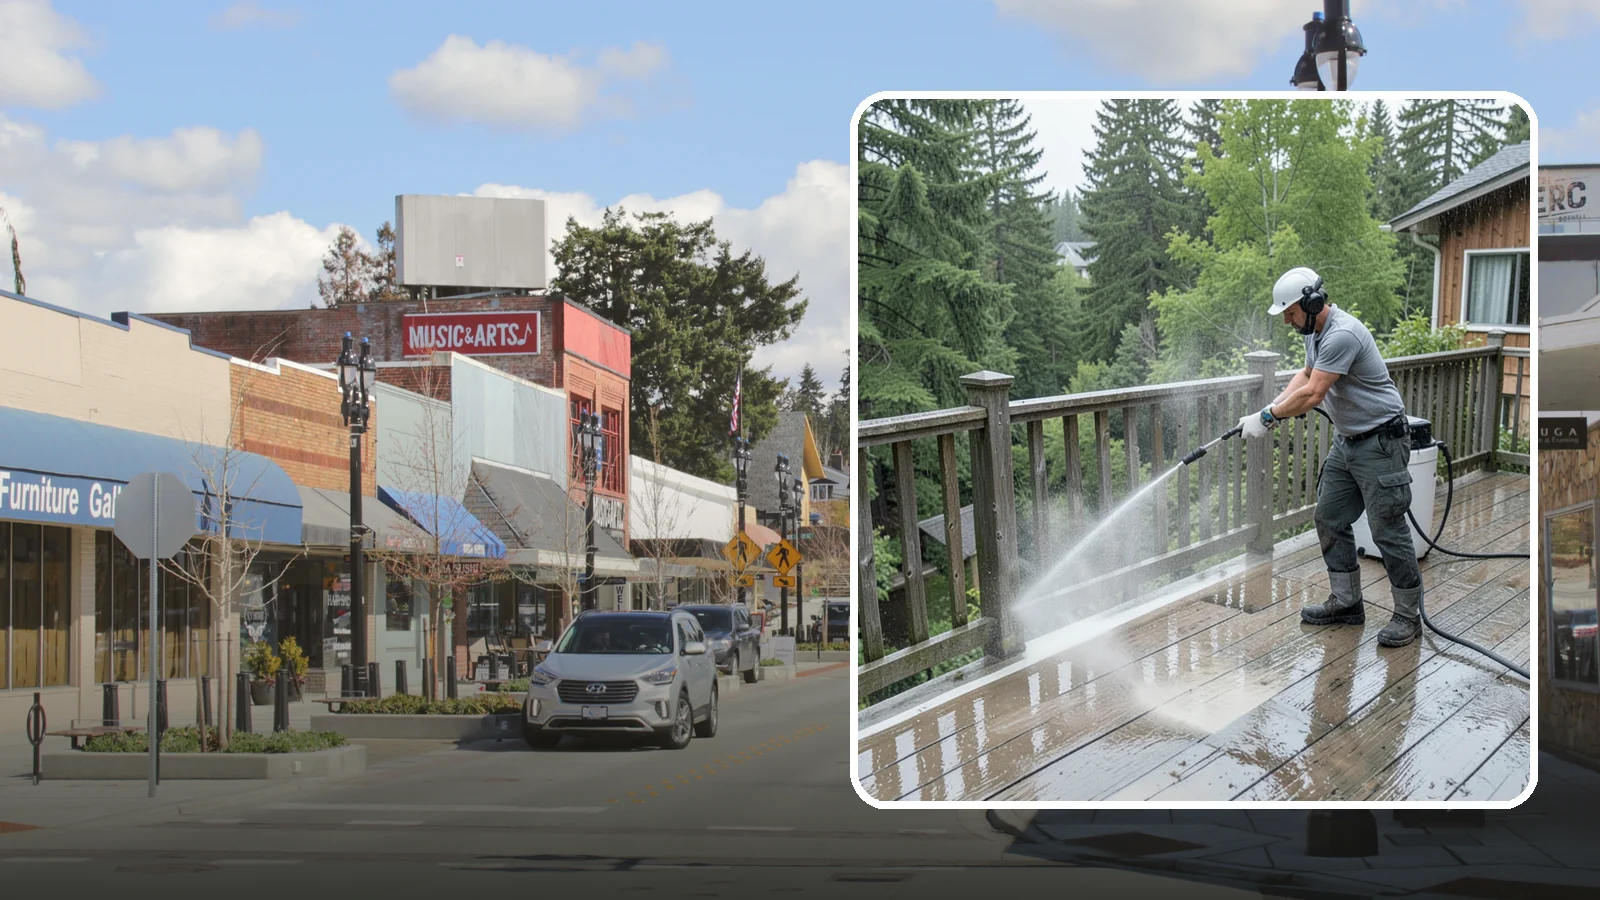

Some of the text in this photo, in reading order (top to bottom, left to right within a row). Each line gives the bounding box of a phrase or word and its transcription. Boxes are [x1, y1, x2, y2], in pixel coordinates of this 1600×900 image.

[0, 471, 122, 519] Furniture Gal
[453, 562, 480, 574] SUSHI
